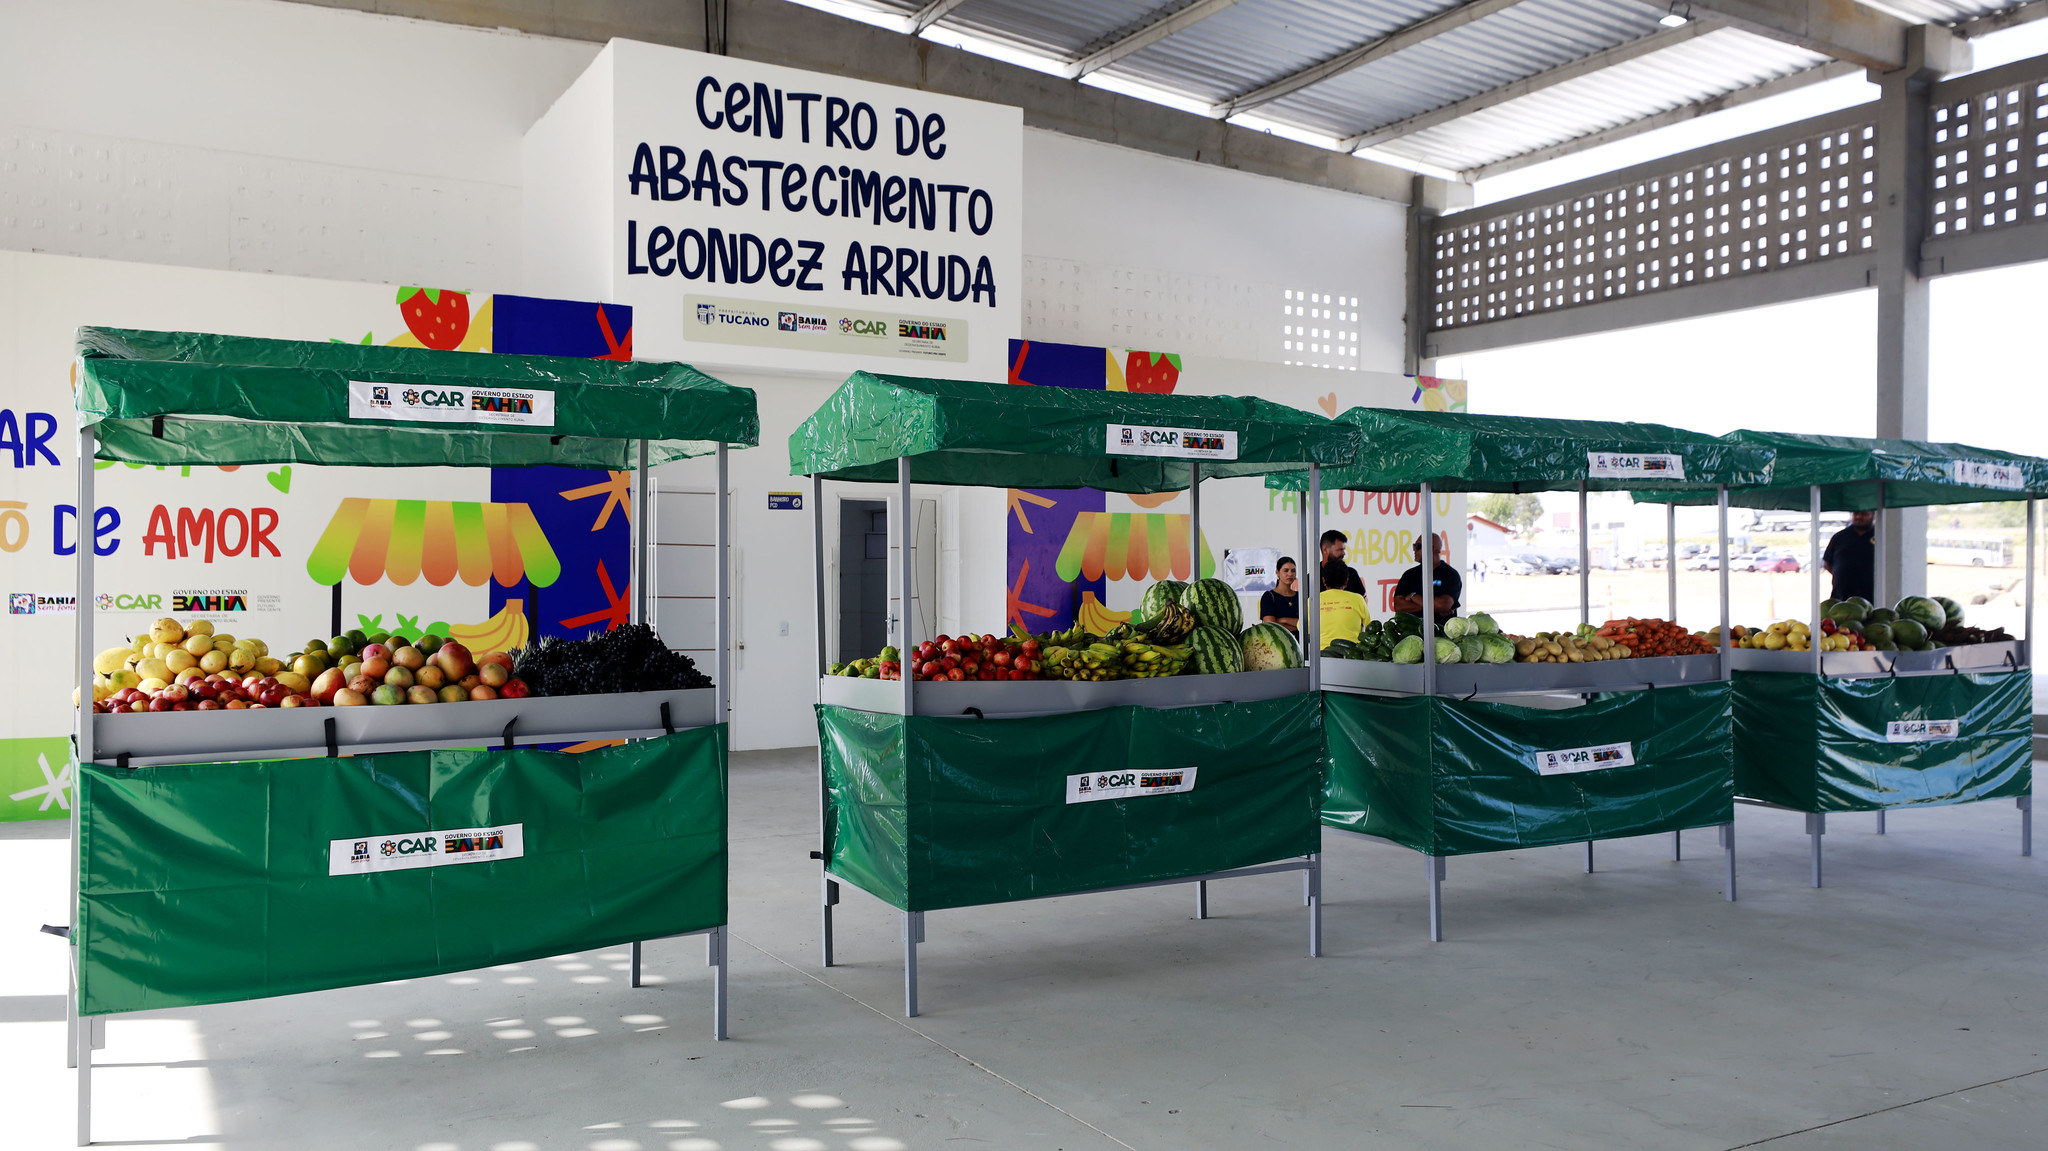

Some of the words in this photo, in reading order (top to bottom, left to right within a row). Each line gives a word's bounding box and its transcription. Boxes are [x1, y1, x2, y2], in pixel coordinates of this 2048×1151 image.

[842, 240, 996, 307] ARRUDA
[719, 314, 769, 327] TUCANO
[798, 316, 827, 326] BAHIA
[853, 319, 887, 336] CAR
[898, 324, 947, 340] BAHIA
[421, 389, 465, 407] CAR
[471, 395, 533, 414] BAHIA
[1150, 430, 1179, 445] CAR
[1183, 436, 1225, 450] BAHIA
[1619, 457, 1640, 468] CAR
[142, 504, 282, 563] AMOR
[1244, 567, 1266, 576] BAHIA
[115, 593, 163, 610] CAR
[172, 595, 248, 611] BAHIA
[1568, 750, 1590, 762] CAR
[1108, 773, 1136, 787] CAR
[1140, 775, 1183, 788] BAHIA
[397, 836, 437, 855] CAR
[445, 835, 504, 854] BAHIA
